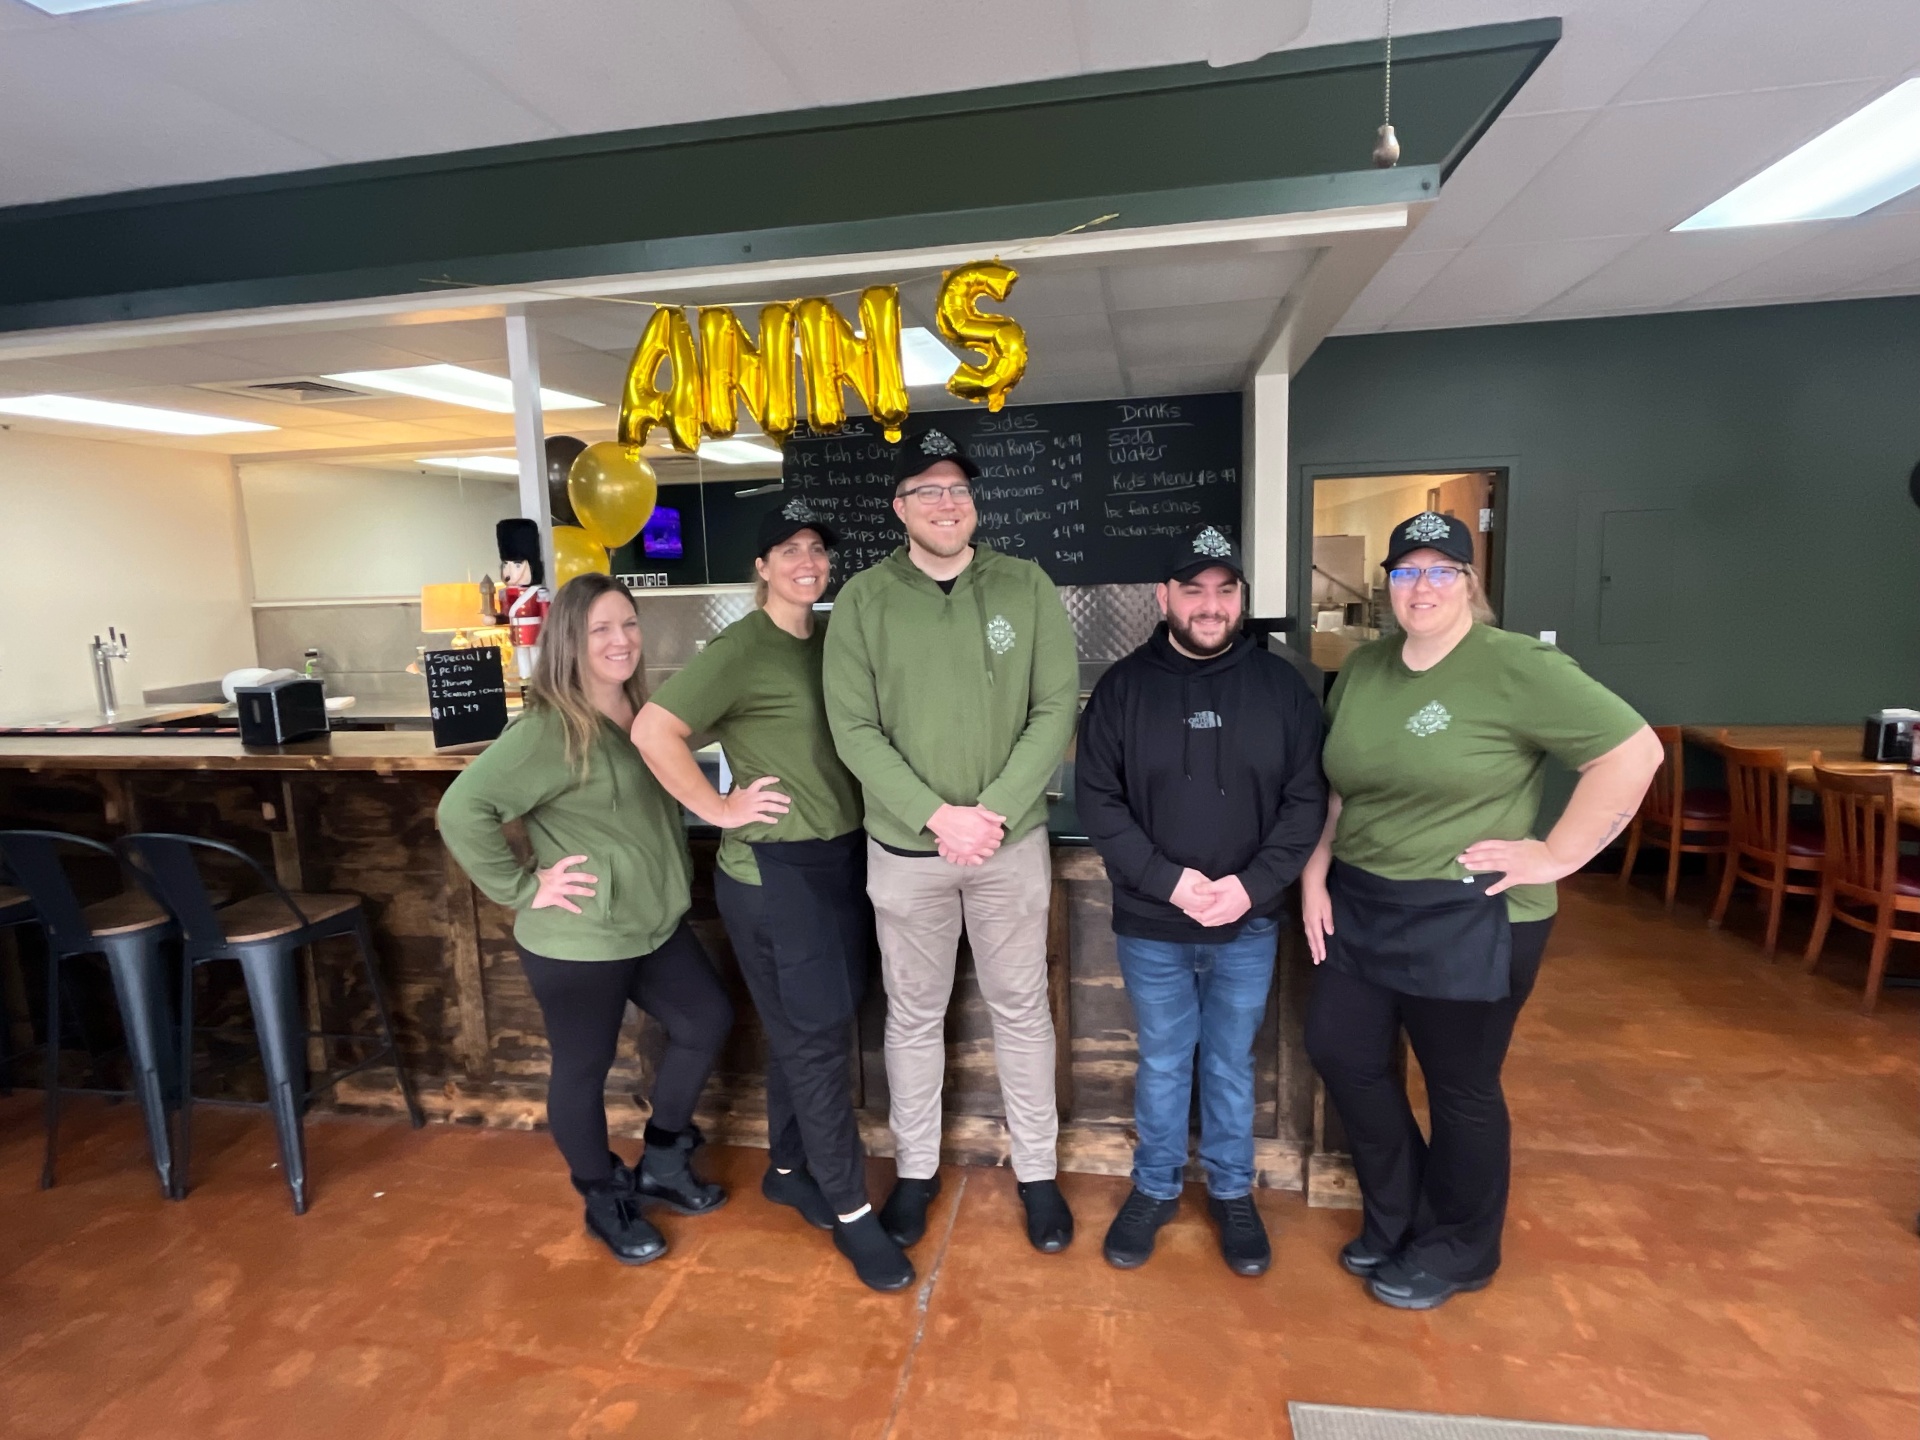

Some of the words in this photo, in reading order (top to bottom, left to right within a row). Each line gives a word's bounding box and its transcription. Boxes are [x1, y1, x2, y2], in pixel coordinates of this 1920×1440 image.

[1117, 403, 1181, 423] Drinks
[979, 413, 1039, 431] Sides
[1108, 428, 1154, 446] Soda
[867, 442, 900, 461] Chip
[1007, 438, 1046, 461] Rings
[1109, 445, 1167, 464] Water
[971, 464, 1035, 480] ucchini
[855, 495, 889, 509] Chips
[1162, 500, 1201, 514] Chips
[850, 512, 886, 525] Chips
[433, 651, 480, 664] Special
[429, 665, 436, 675] 1
[431, 679, 438, 688] 2
[432, 690, 440, 698] 2
